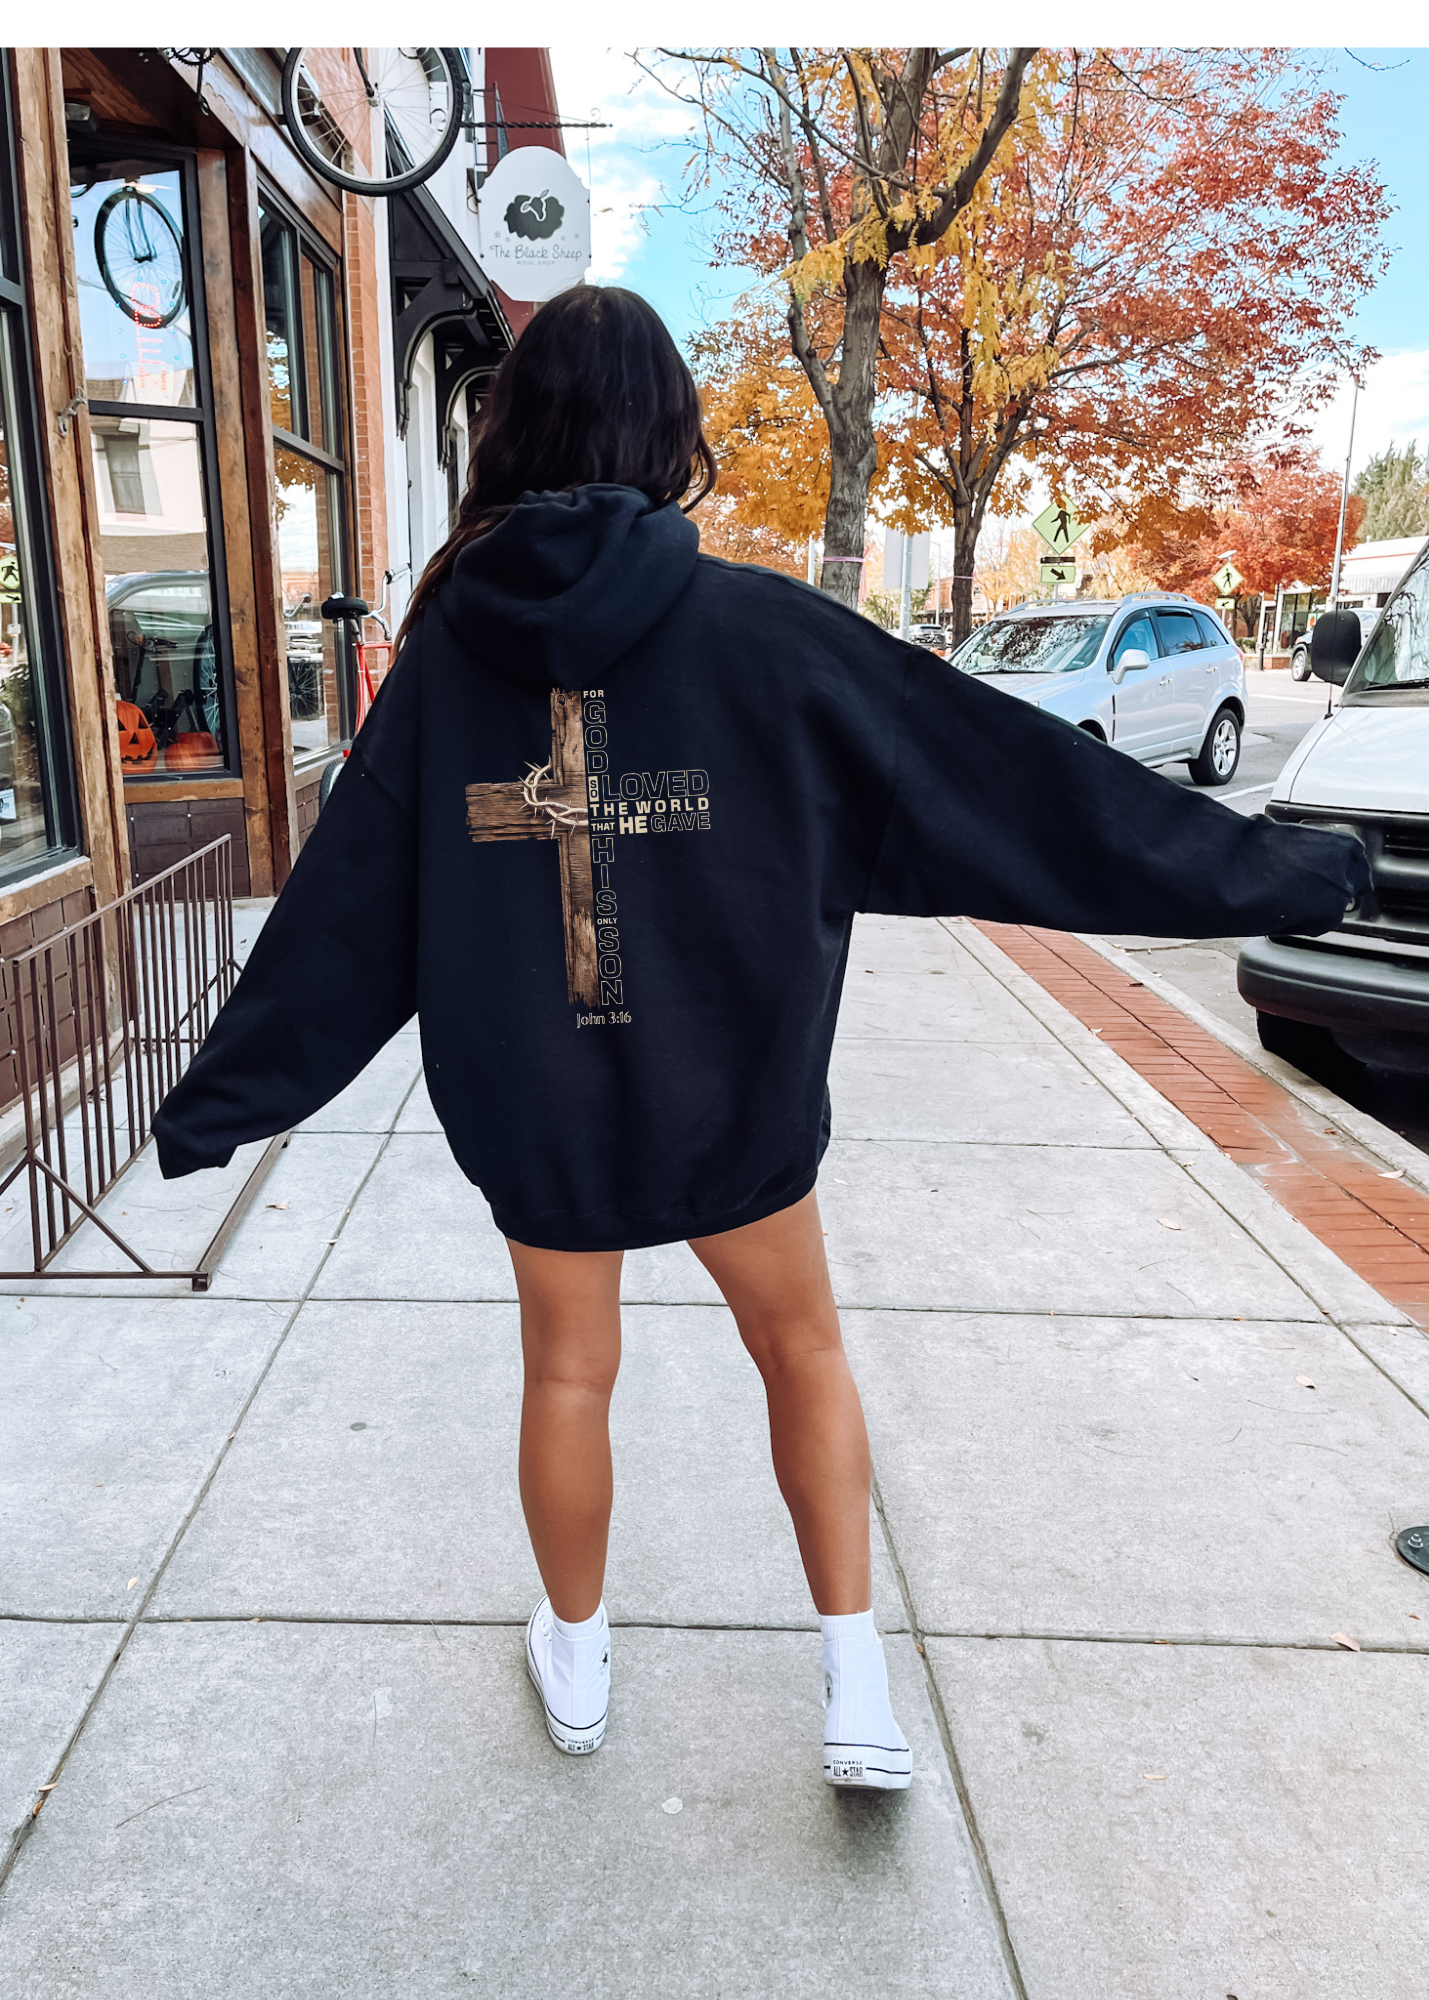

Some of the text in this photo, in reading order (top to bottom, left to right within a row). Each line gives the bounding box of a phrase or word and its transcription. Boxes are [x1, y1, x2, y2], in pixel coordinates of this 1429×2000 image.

[490, 243, 582, 261] The Black Sheep
[130, 283, 167, 393] OPEN
[583, 689, 605, 699] FOR
[583, 700, 609, 774] GOD
[589, 778, 599, 800] SO
[602, 769, 710, 802] LOVED
[590, 797, 709, 817] THE WORLD
[591, 811, 711, 835] THAT HE GAVE
[591, 837, 618, 916] HIS
[596, 917, 618, 925] ONLY
[598, 926, 624, 1006] SON
[576, 1011, 632, 1029] John 3:16
[833, 1766, 863, 1777] ALL STAR
